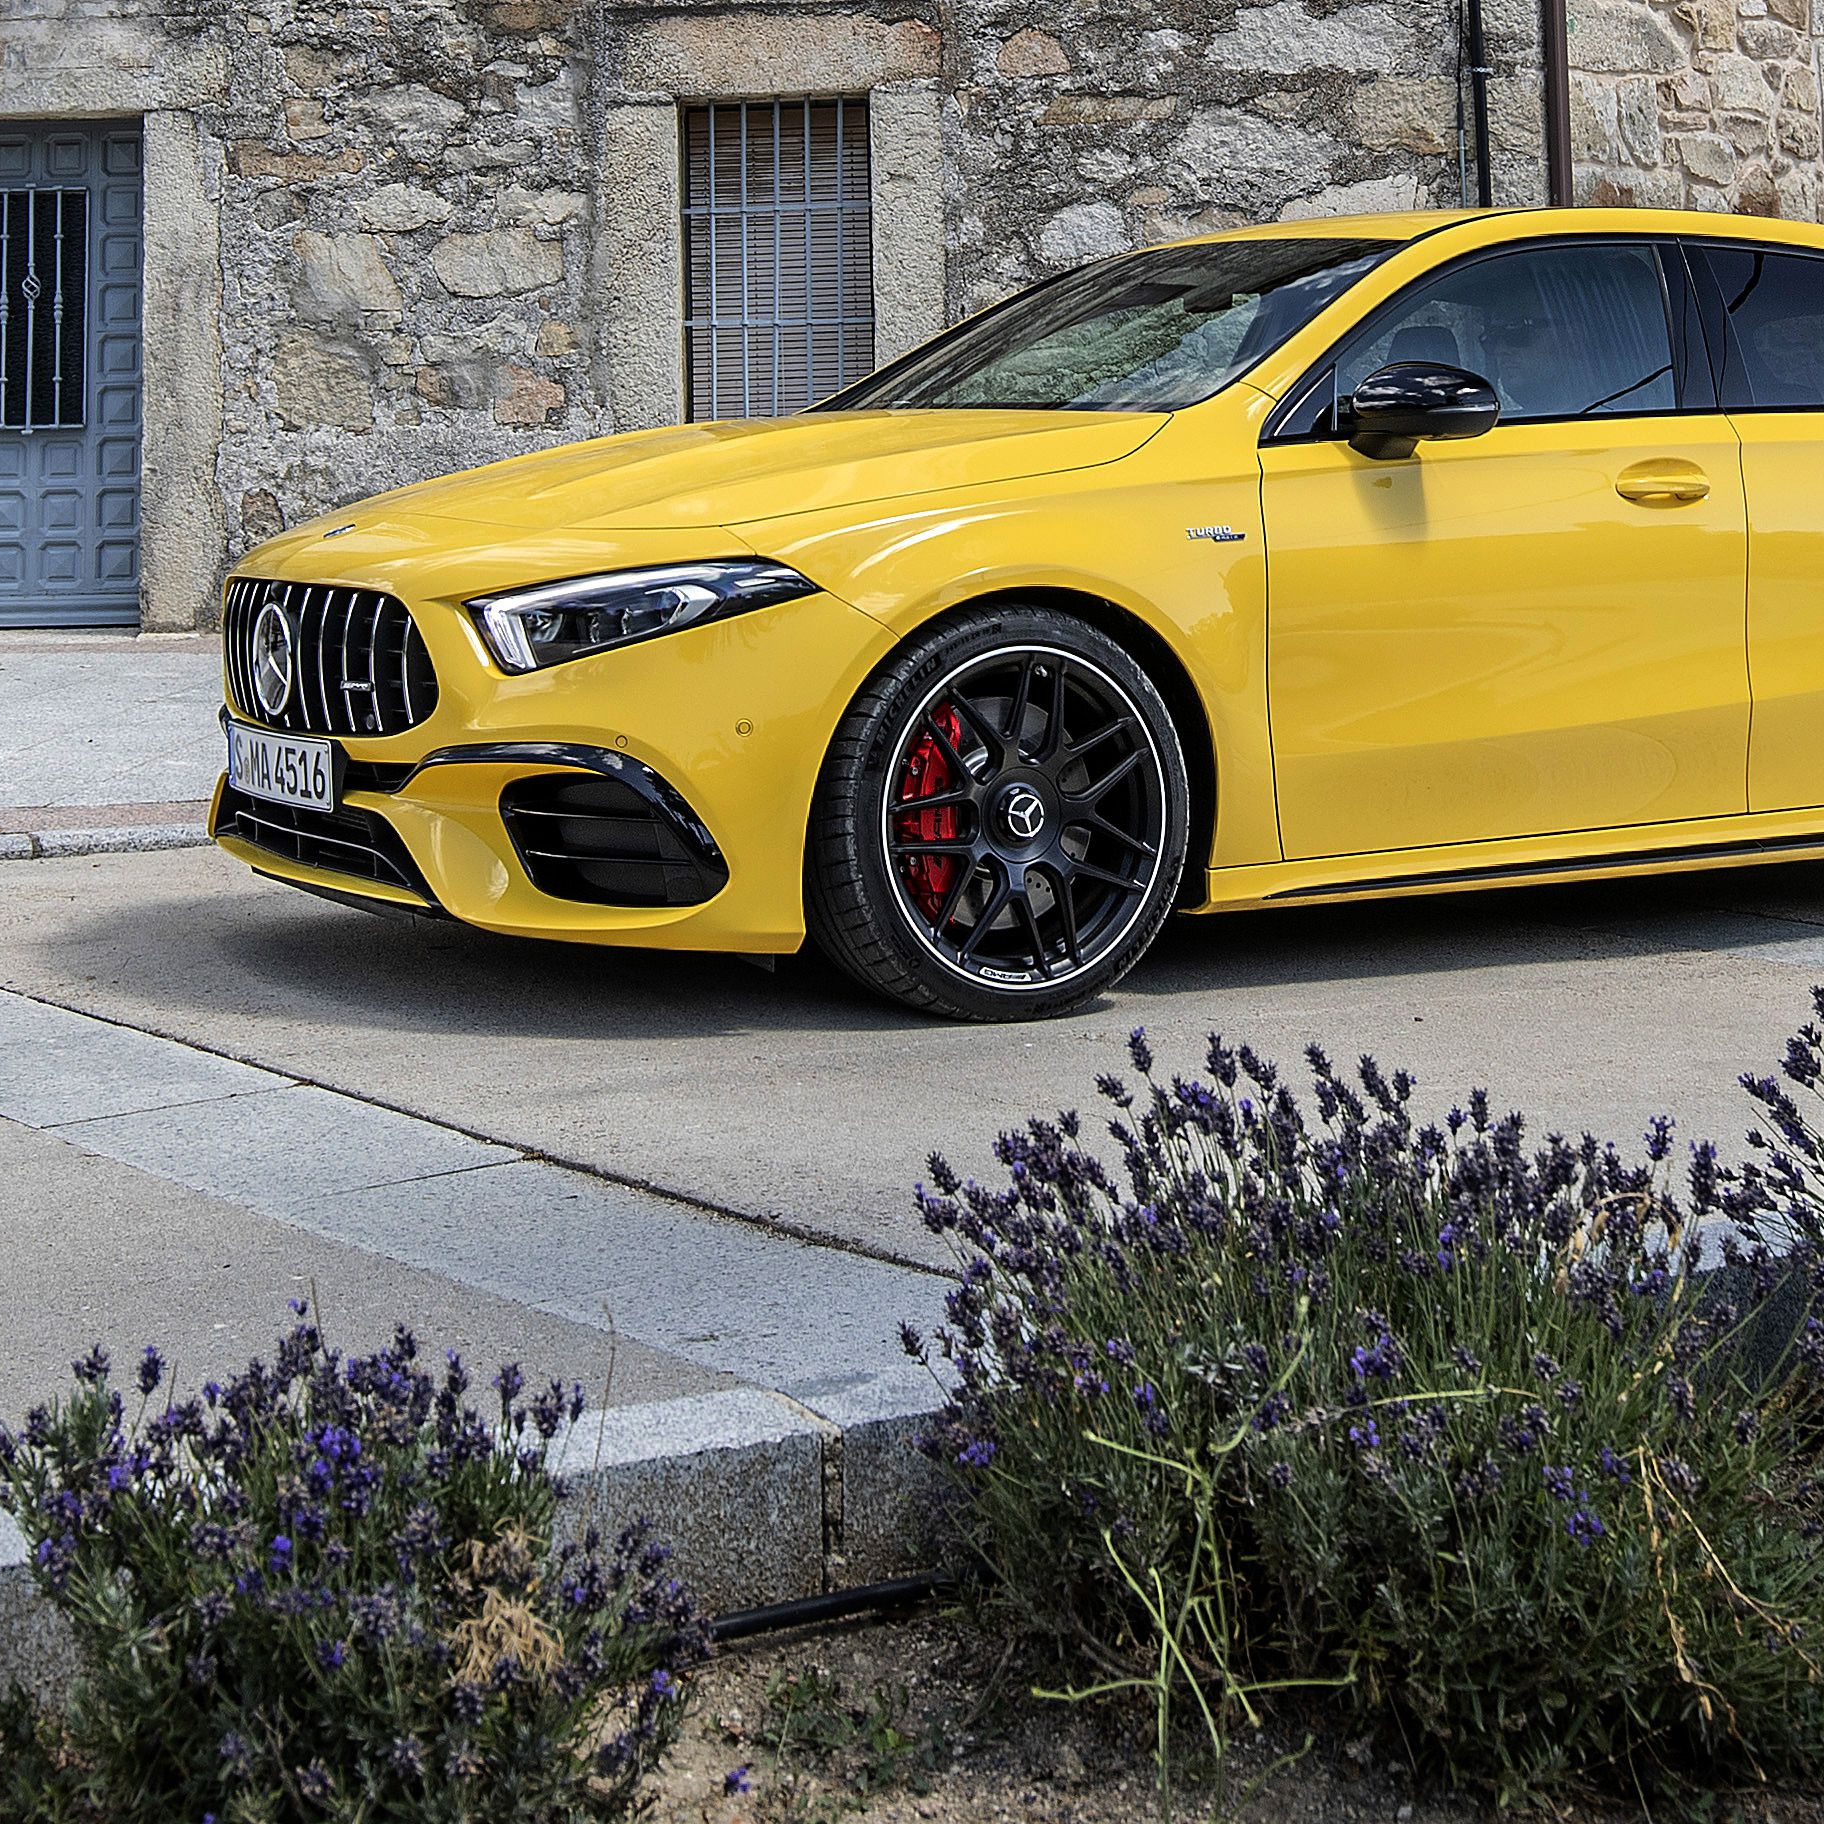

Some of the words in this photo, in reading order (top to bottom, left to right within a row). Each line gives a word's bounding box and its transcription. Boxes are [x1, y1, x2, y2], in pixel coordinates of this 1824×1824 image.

[1186, 525, 1232, 537] TURBO
[876, 656, 939, 746] MICHELIN
[235, 734, 243, 781] S
[250, 738, 272, 791] MA
[274, 747, 326, 800] 4516
